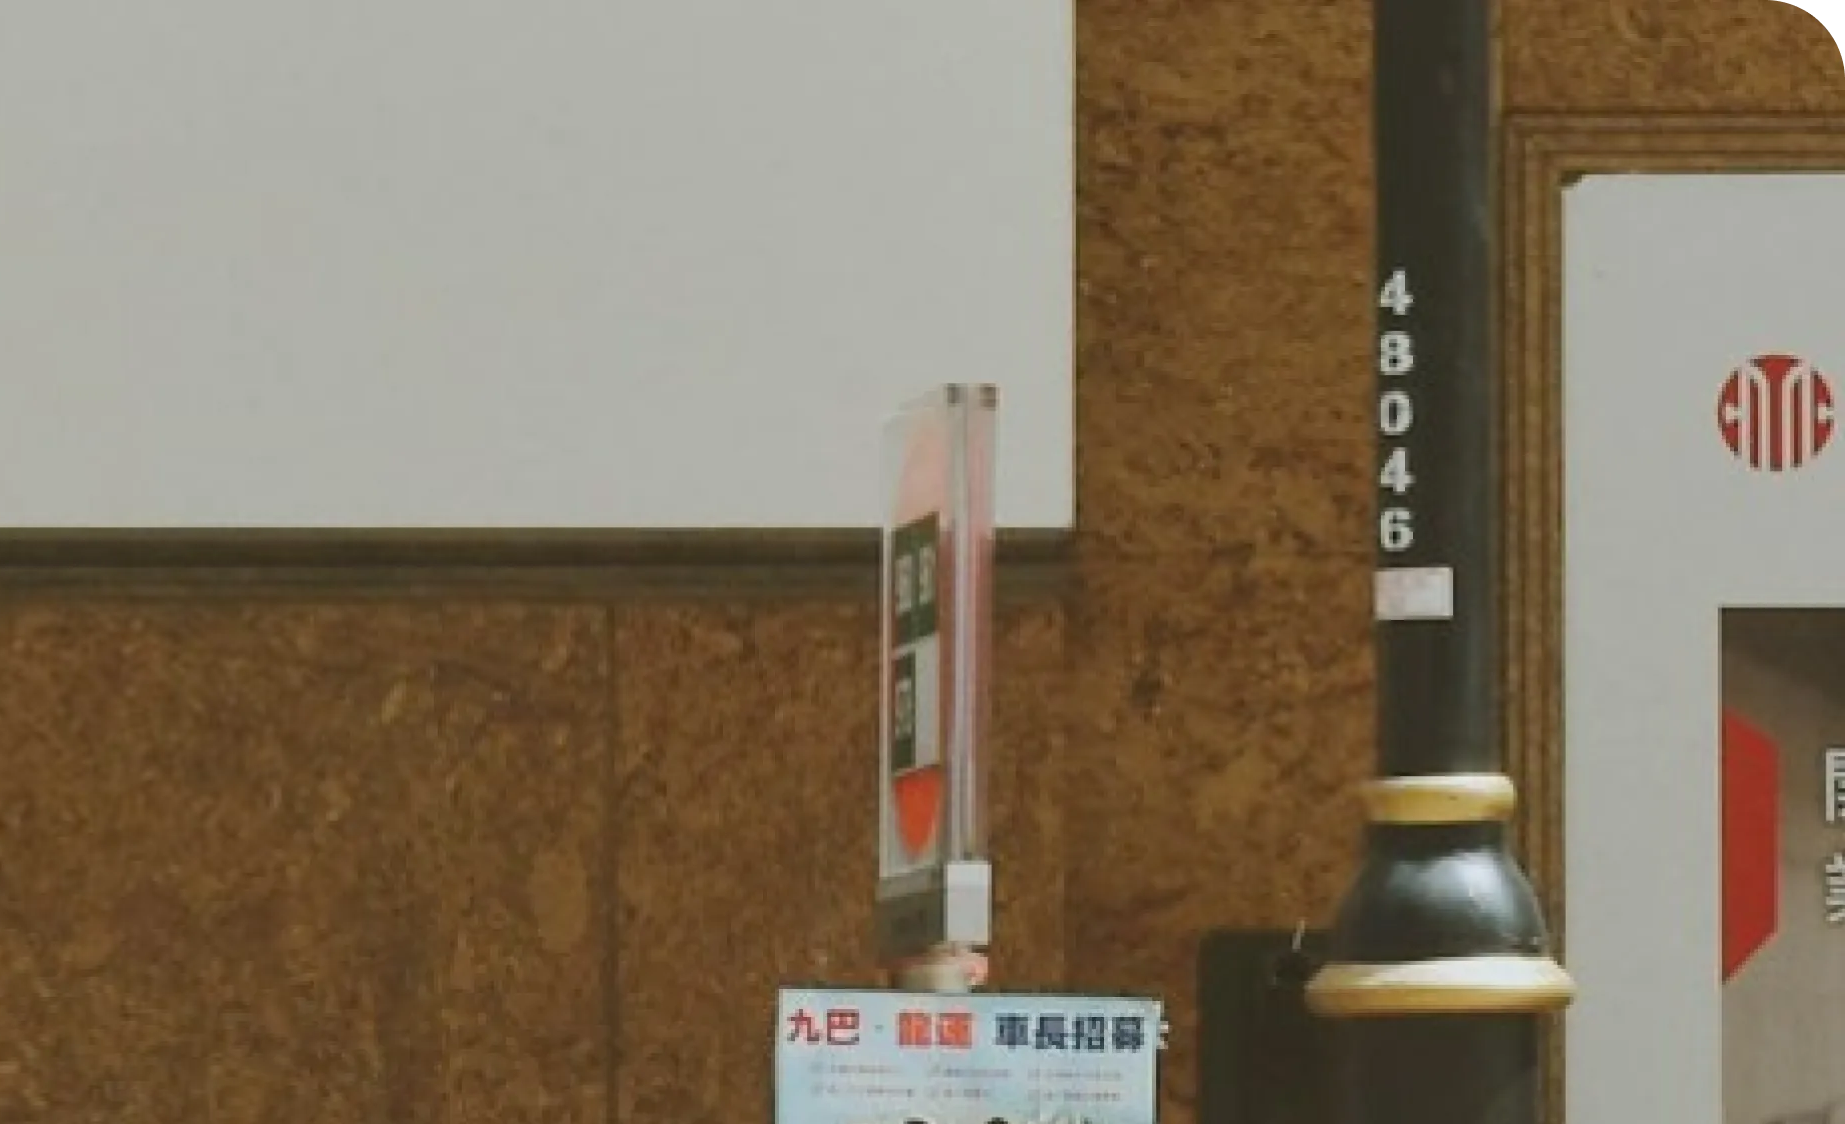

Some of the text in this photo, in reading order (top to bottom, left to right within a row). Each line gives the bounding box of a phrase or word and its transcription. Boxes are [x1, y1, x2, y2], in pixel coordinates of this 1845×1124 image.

[1380, 268, 1414, 552] 48046
[787, 1008, 860, 1046] 九巴
[995, 1012, 1145, 1051] 車長招募
